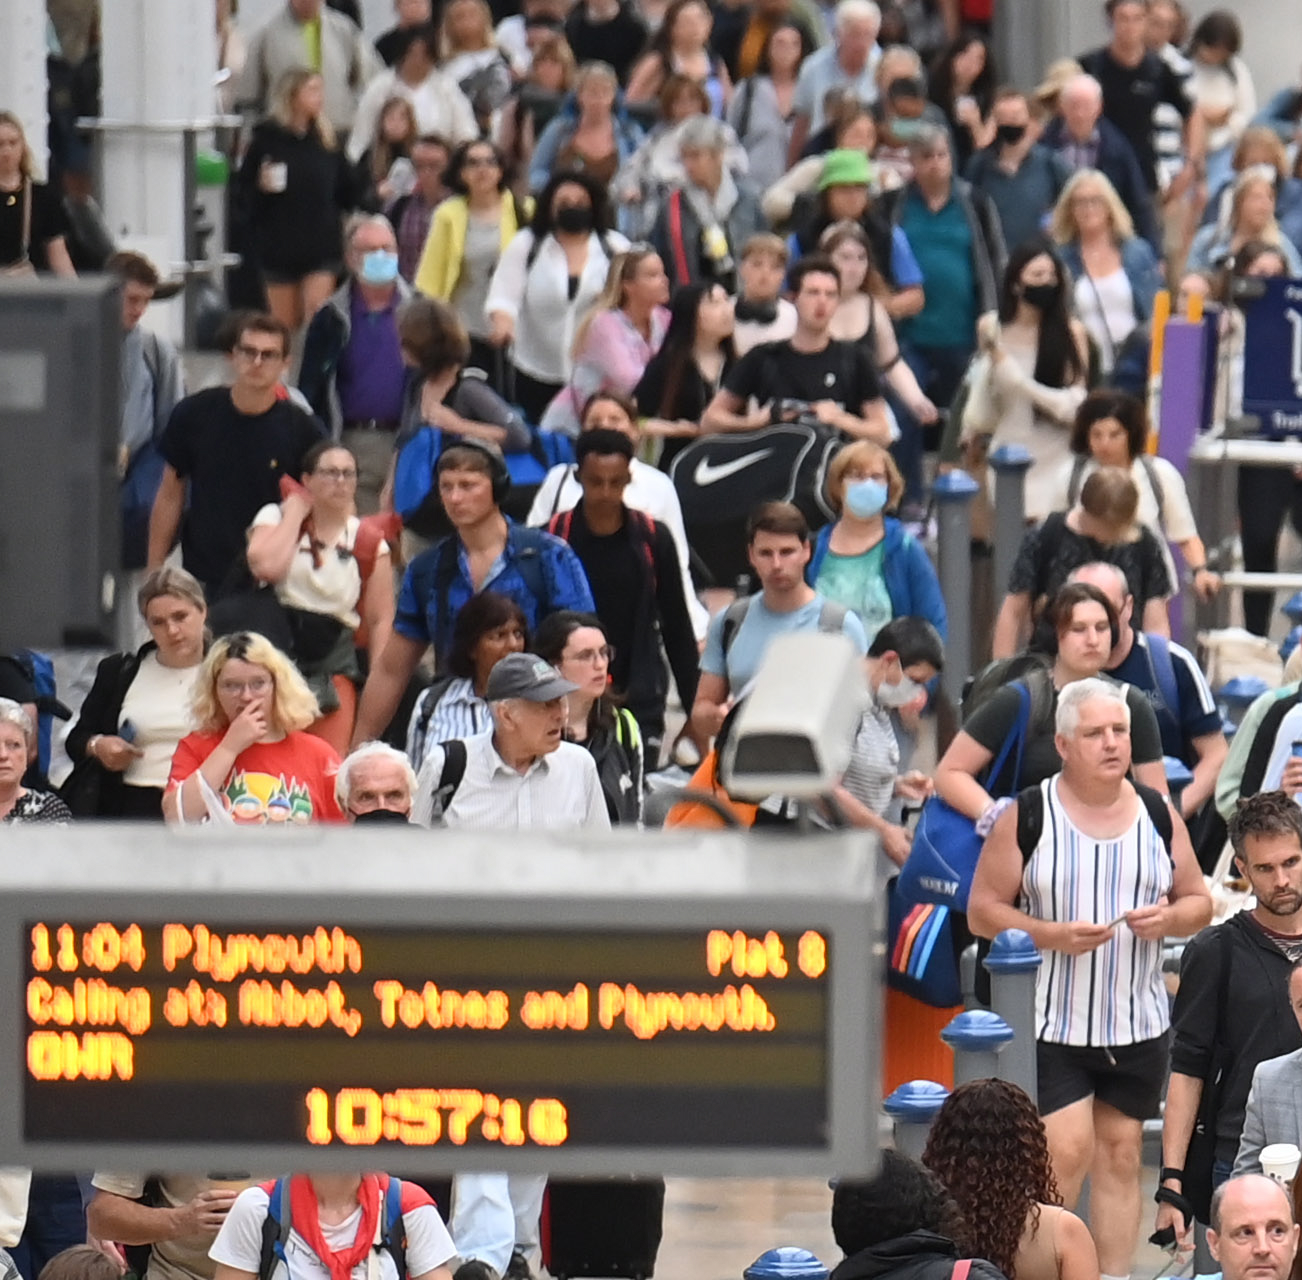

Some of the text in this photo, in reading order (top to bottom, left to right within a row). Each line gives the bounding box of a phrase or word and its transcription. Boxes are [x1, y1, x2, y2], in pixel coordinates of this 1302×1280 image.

[31, 922, 826, 982] 11:04 Plymouth Plat 8
[26, 976, 151, 1036] Calling
[238, 979, 363, 1037] Abbot,
[373, 980, 510, 1030] Totnes
[520, 982, 590, 1031] and
[598, 982, 777, 1040] Plymouth.
[26, 1030, 135, 1081] GWR
